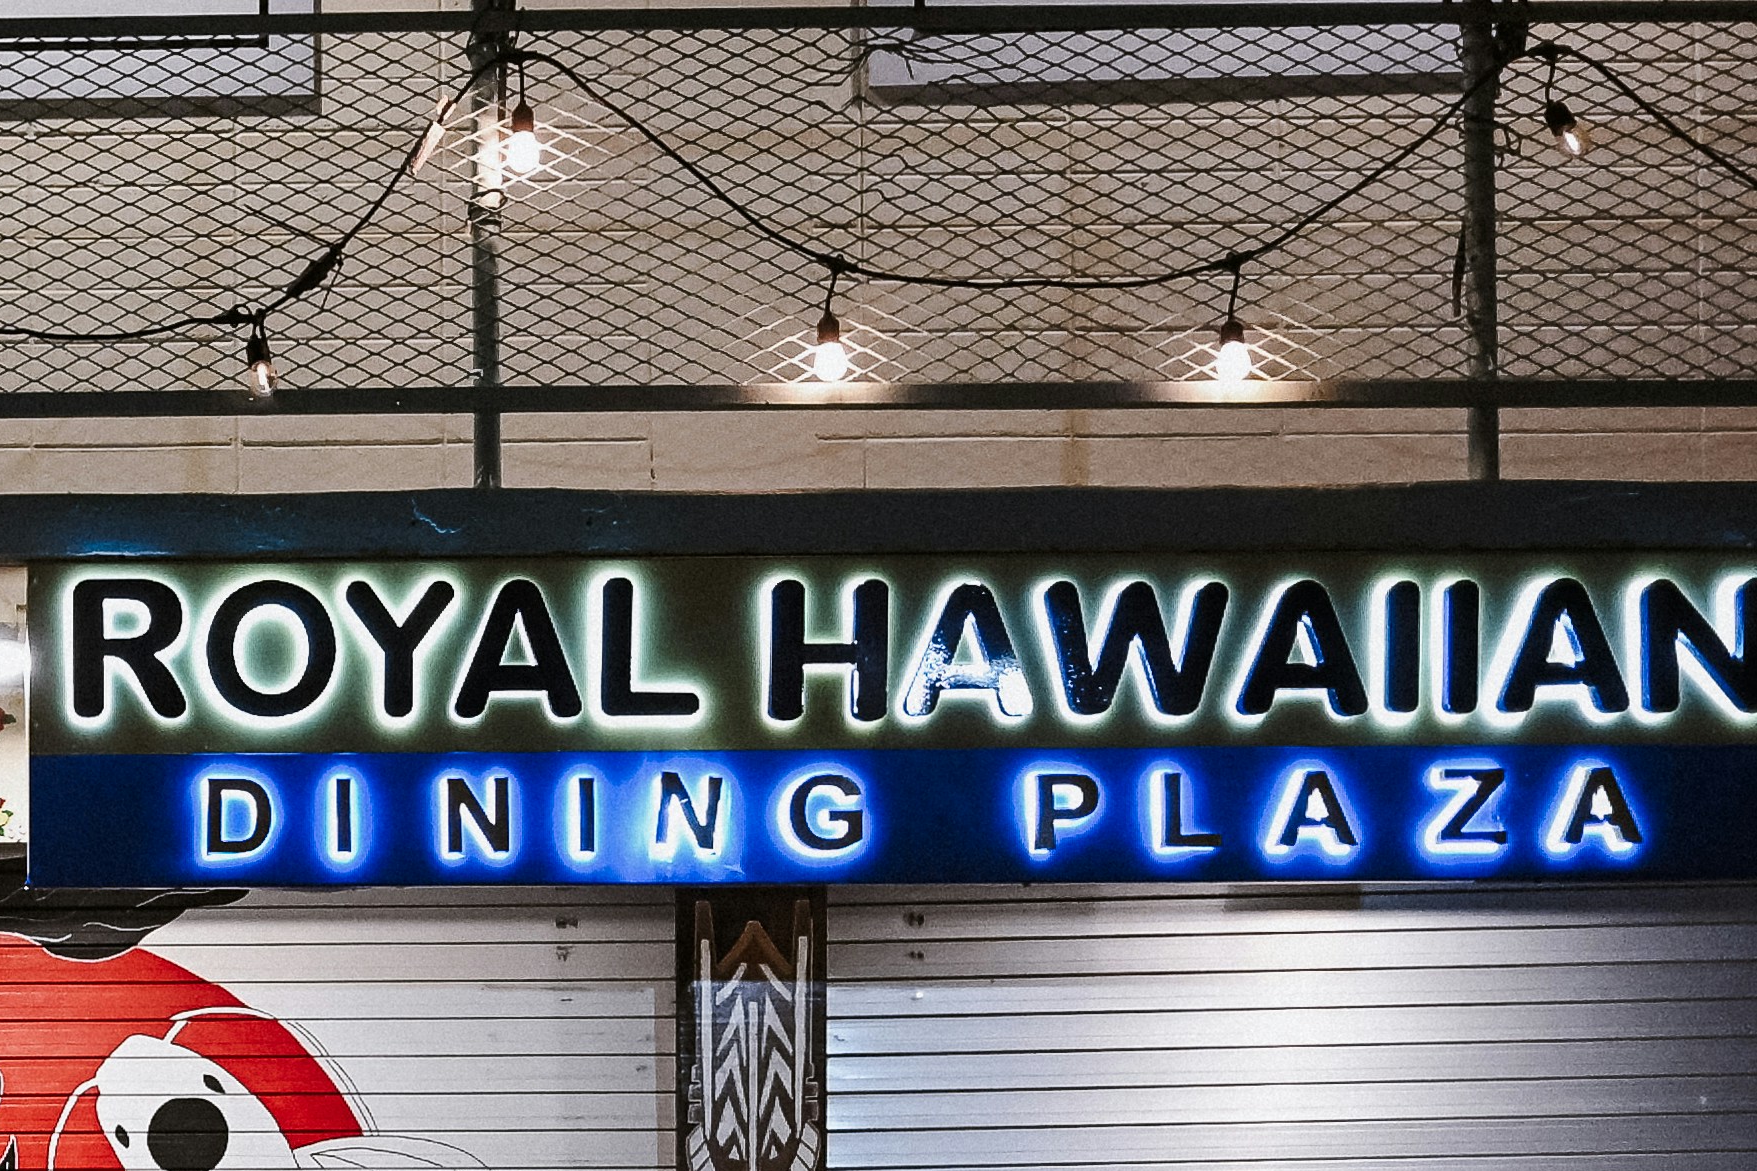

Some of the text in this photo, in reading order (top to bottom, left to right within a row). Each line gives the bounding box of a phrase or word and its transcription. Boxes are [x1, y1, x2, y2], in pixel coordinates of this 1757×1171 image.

[71, 576, 1757, 722] ROYAL HAWAIIAN
[204, 766, 1644, 857] DINING PLAZA
